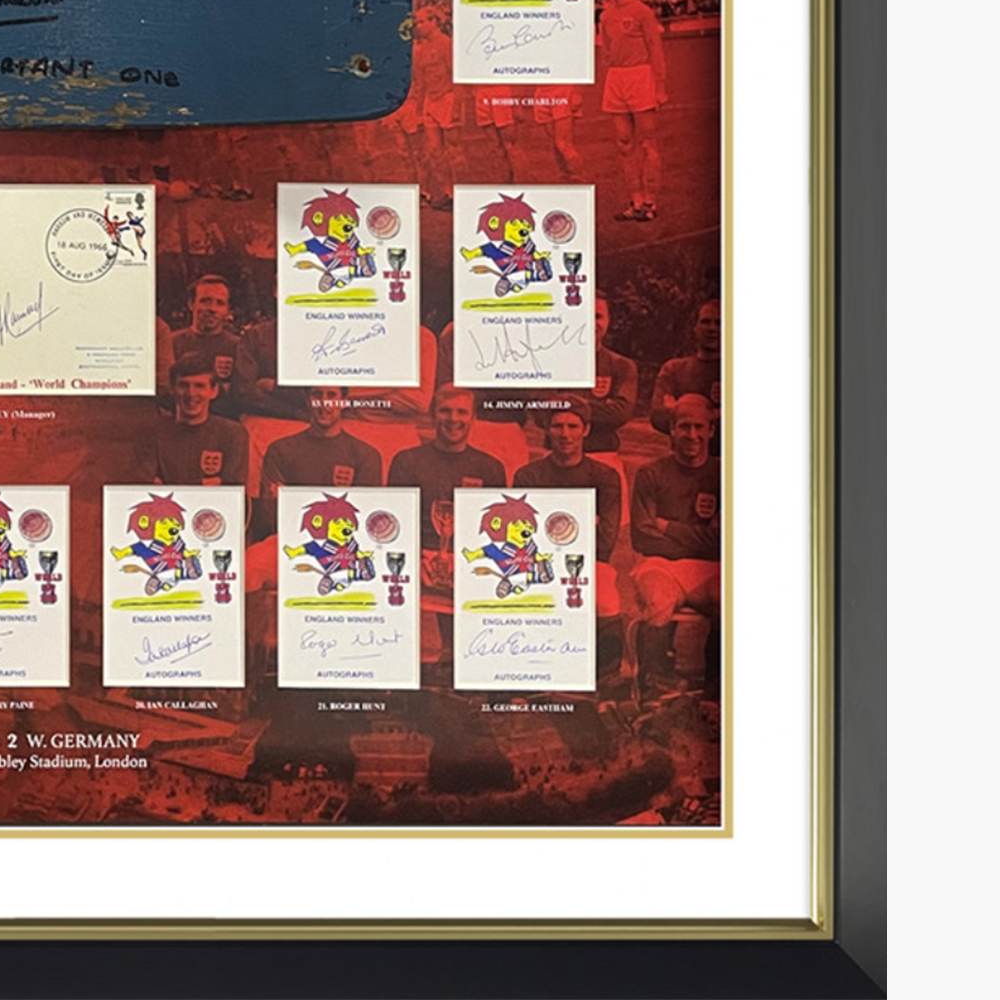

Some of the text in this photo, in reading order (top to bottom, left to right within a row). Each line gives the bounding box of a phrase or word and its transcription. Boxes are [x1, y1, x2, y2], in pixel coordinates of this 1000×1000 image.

[480, 11, 562, 20] ENGLAND WINNERS
[492, 67, 551, 75] AUTOGRAPHS
[69, 242, 86, 250] AUG
[305, 312, 387, 321] ENGLAND WINNERS
[481, 316, 563, 325] ENGLAND WINNERS
[317, 368, 376, 376] AUTOGRAPHS
[494, 372, 553, 380] AUTOGRAPHS
[525, 400, 572, 409] ARMFIELD
[11, 410, 56, 420] (Manager)
[0, 614, 38, 623] WINNERS
[131, 615, 213, 624] ENGLAND WINNERS
[304, 615, 386, 624] ENGLAND WINNERS
[482, 618, 564, 627] ENGLAND WINNERS
[144, 671, 203, 679] AUTOGRAPHS
[316, 671, 375, 679] AUTOGRAPHS
[493, 674, 552, 682] AUTOGRAPHS
[9, 701, 35, 710] PAINE
[147, 701, 163, 710] IAN
[164, 701, 218, 710] CALLAGHAN
[330, 702, 360, 711] ROGER
[362, 702, 386, 711] HUNT
[493, 703, 530, 712] GEORGE
[531, 703, 574, 712] EASTHAM
[7, 733, 18, 748] 2
[26, 734, 47, 748] W.
[50, 733, 140, 748] GERMANY
[29, 754, 91, 769] Stadium,
[94, 754, 148, 768] London
